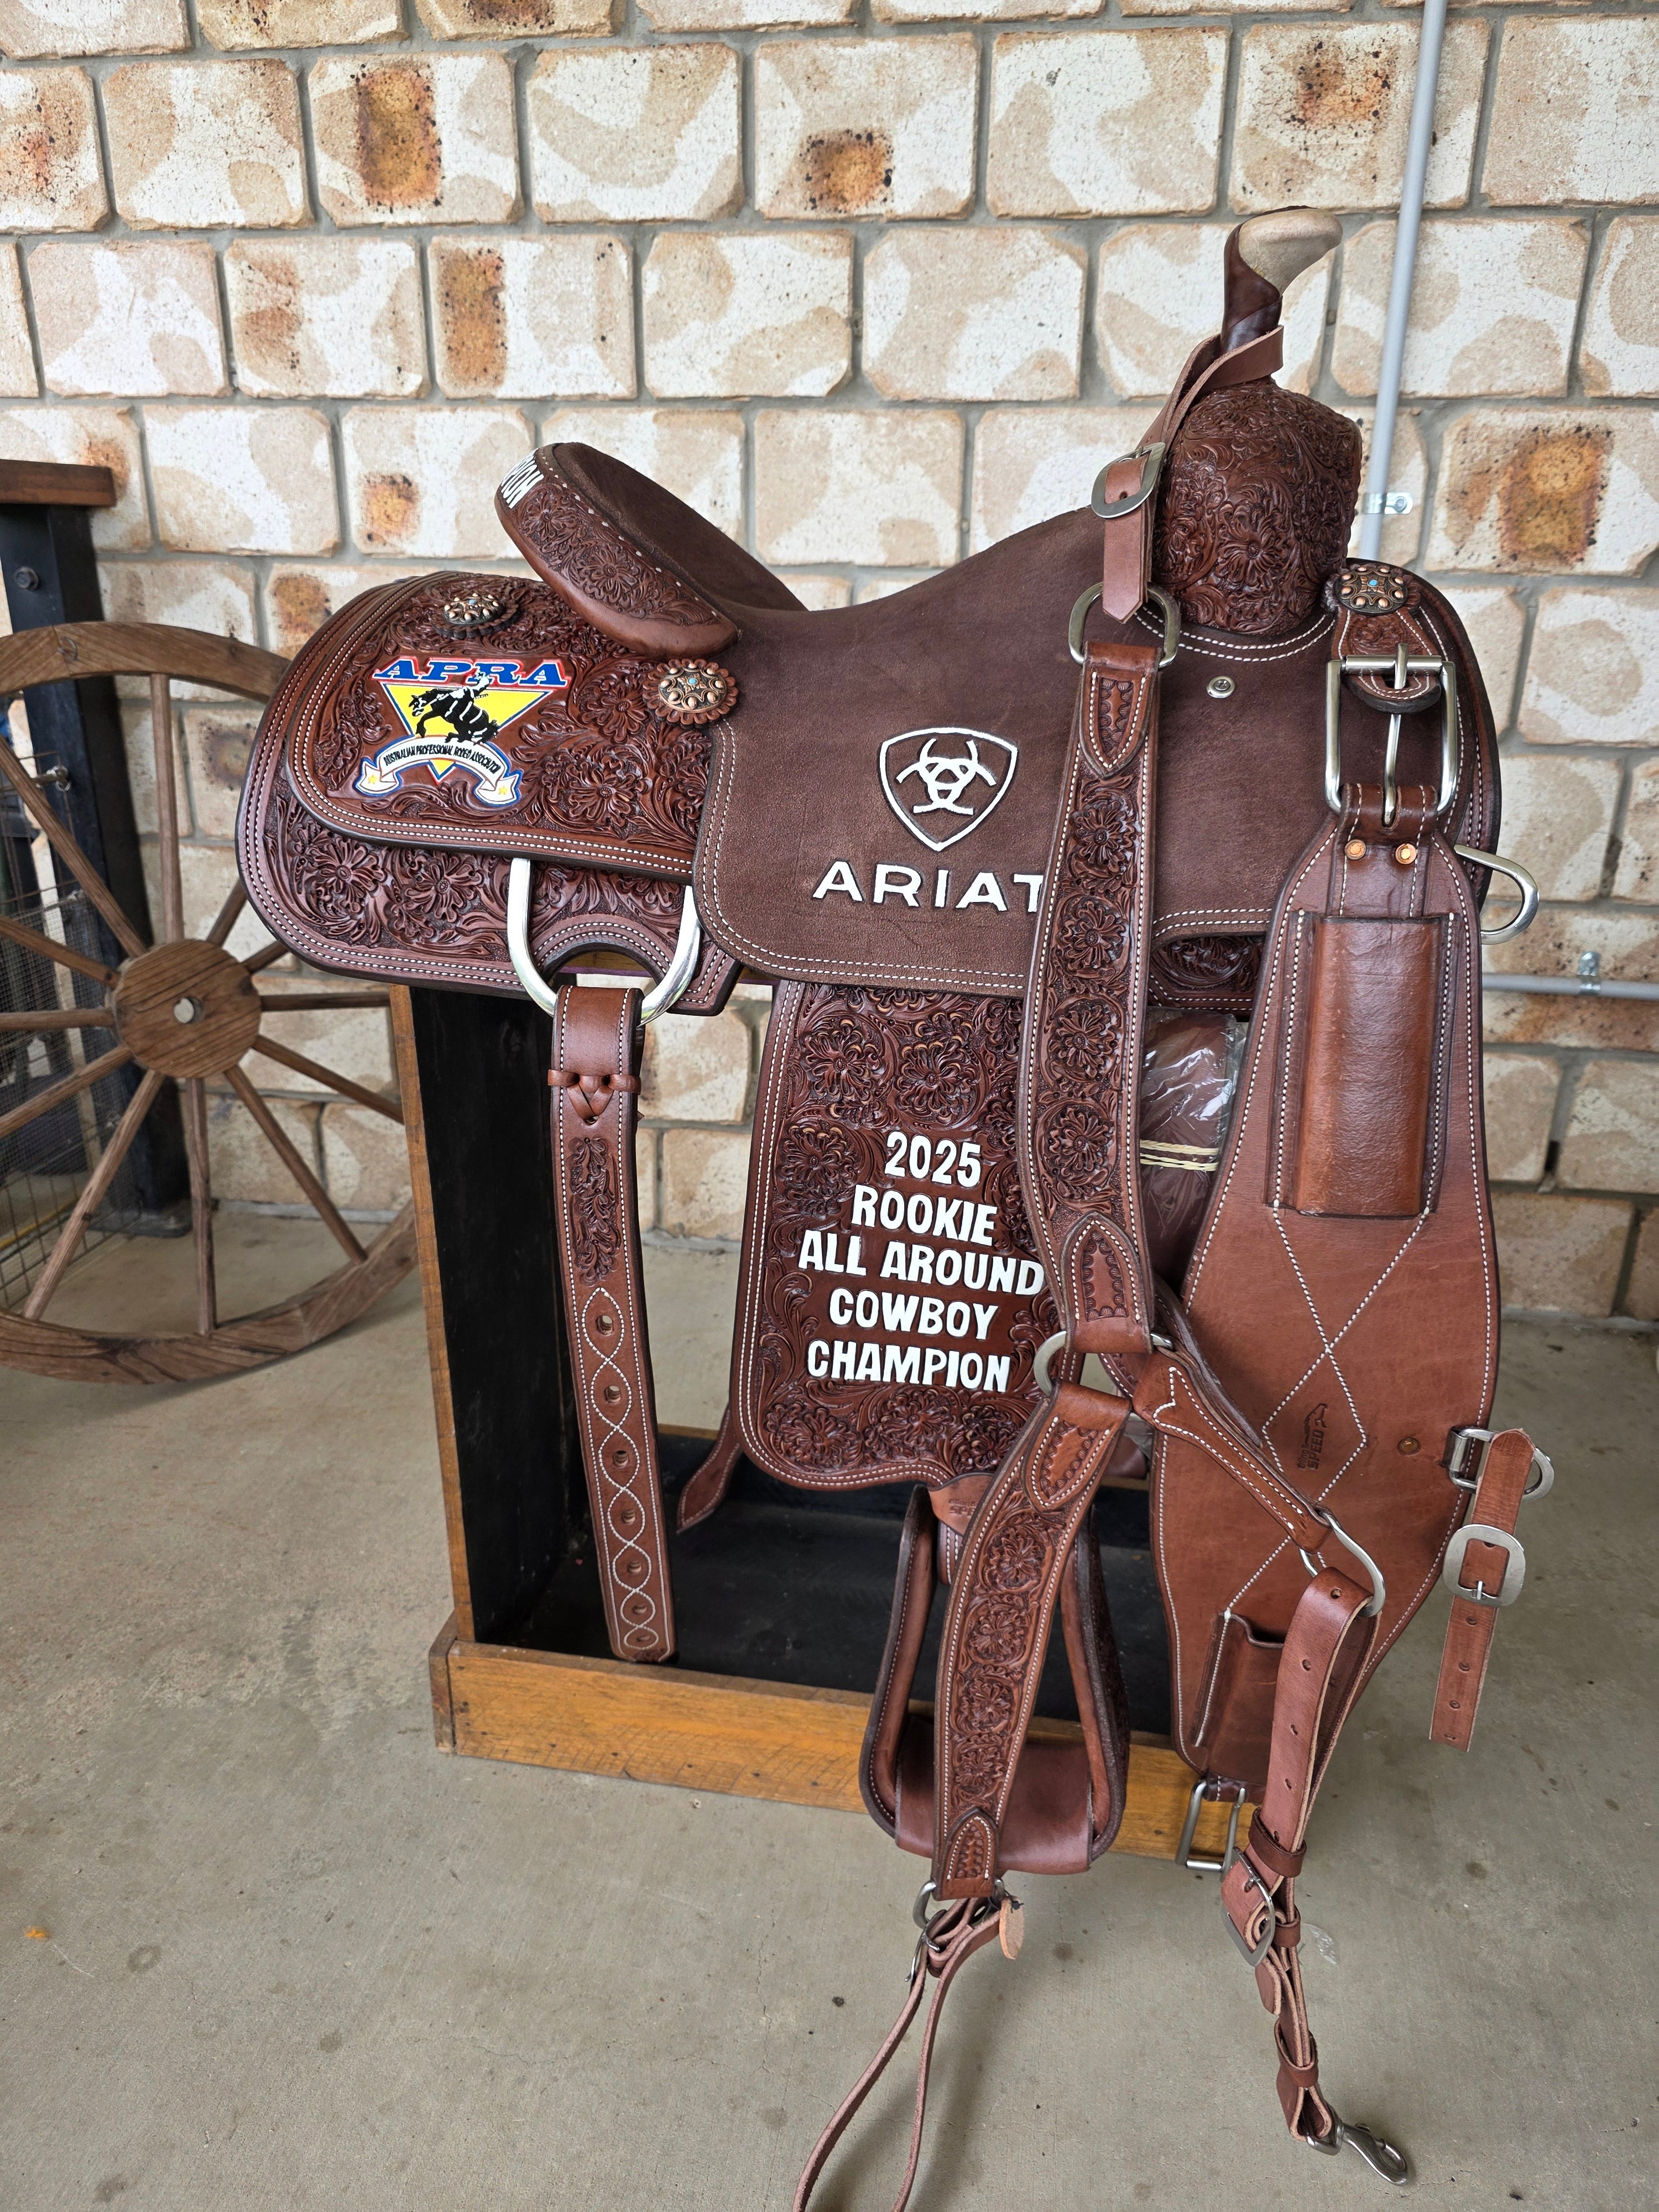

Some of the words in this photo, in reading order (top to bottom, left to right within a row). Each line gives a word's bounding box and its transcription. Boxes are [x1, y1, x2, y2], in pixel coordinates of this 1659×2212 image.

[373, 658, 569, 687] APRA
[454, 746, 471, 759] RODEO
[812, 860, 1045, 913] ARIAT
[884, 1131, 981, 1187] 2025
[851, 1184, 998, 1246] ROOKIE
[798, 1229, 867, 1276] ALL
[879, 1241, 1045, 1295] AROUND
[829, 1288, 999, 1340] COWBOY
[807, 1340, 1011, 1392] CHAMPION
[1307, 1429, 1324, 1470] SPEED
[949, 1505, 975, 1516] SPE
